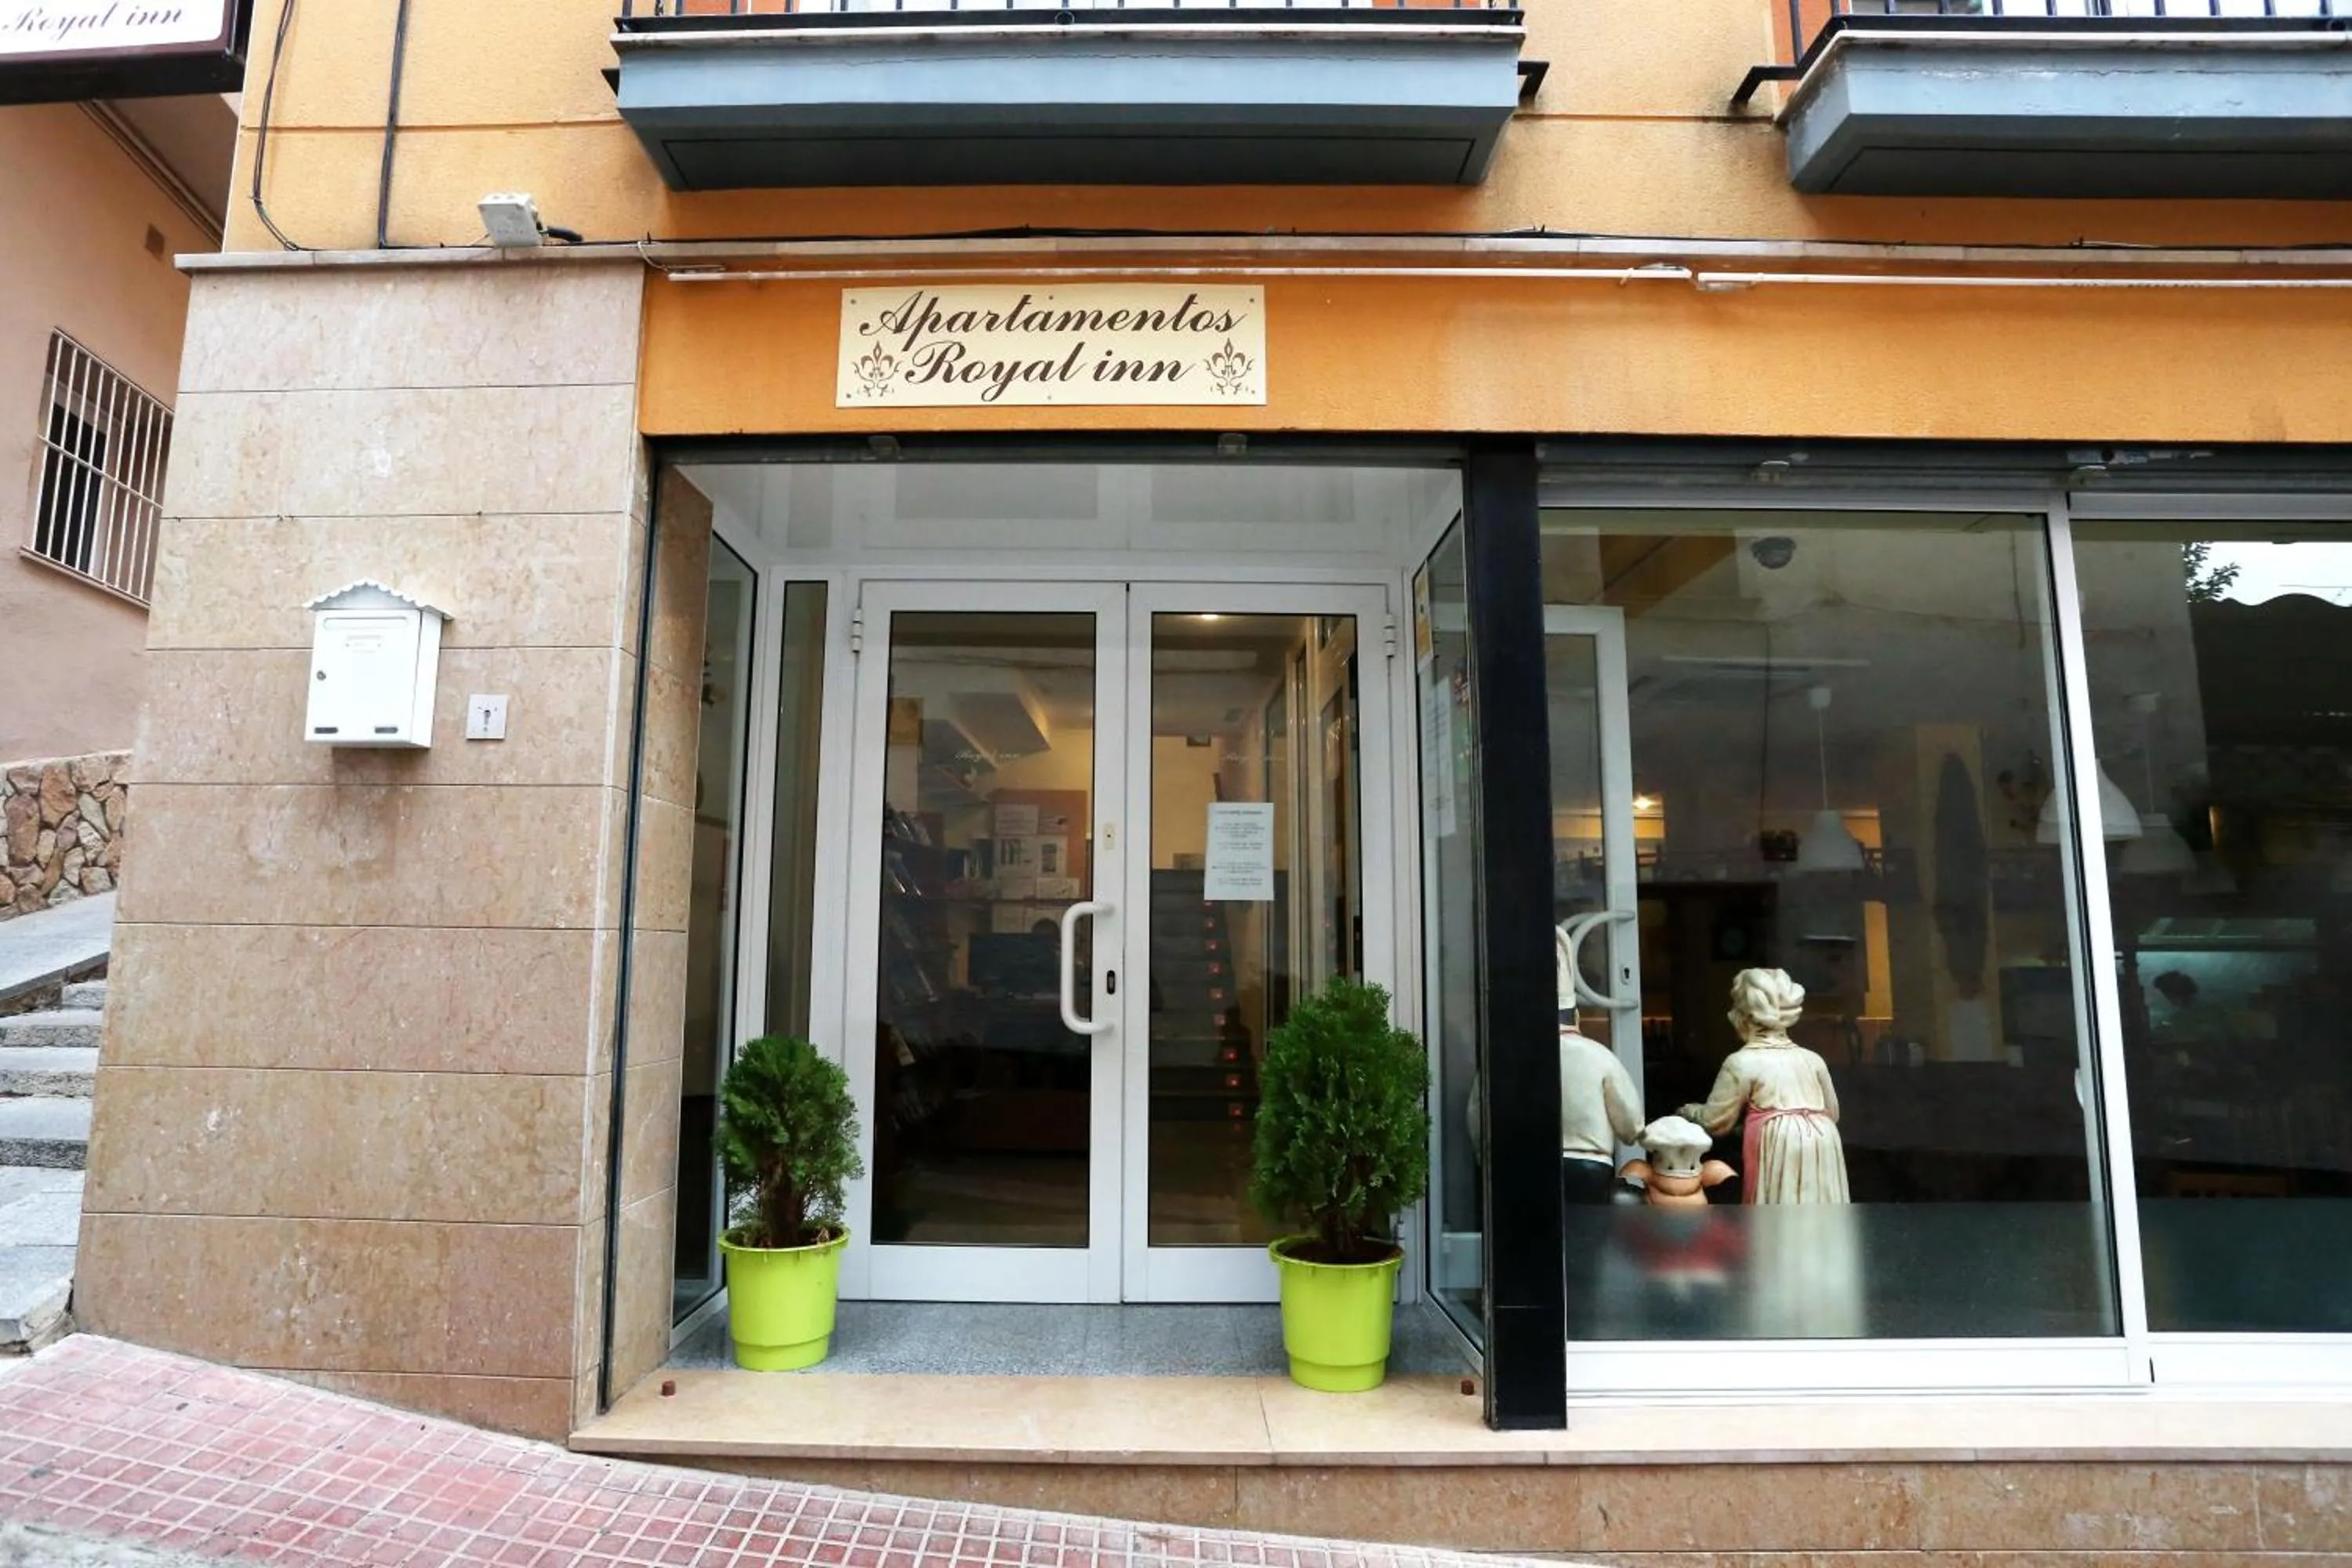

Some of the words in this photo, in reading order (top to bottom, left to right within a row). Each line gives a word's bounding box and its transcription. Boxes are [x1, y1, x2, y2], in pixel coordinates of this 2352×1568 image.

[2, 2, 118, 41] Royal
[126, 5, 183, 26] inn
[858, 291, 1247, 351] Apartamentos
[905, 340, 1085, 401] Royal
[1093, 350, 1196, 383] inn
